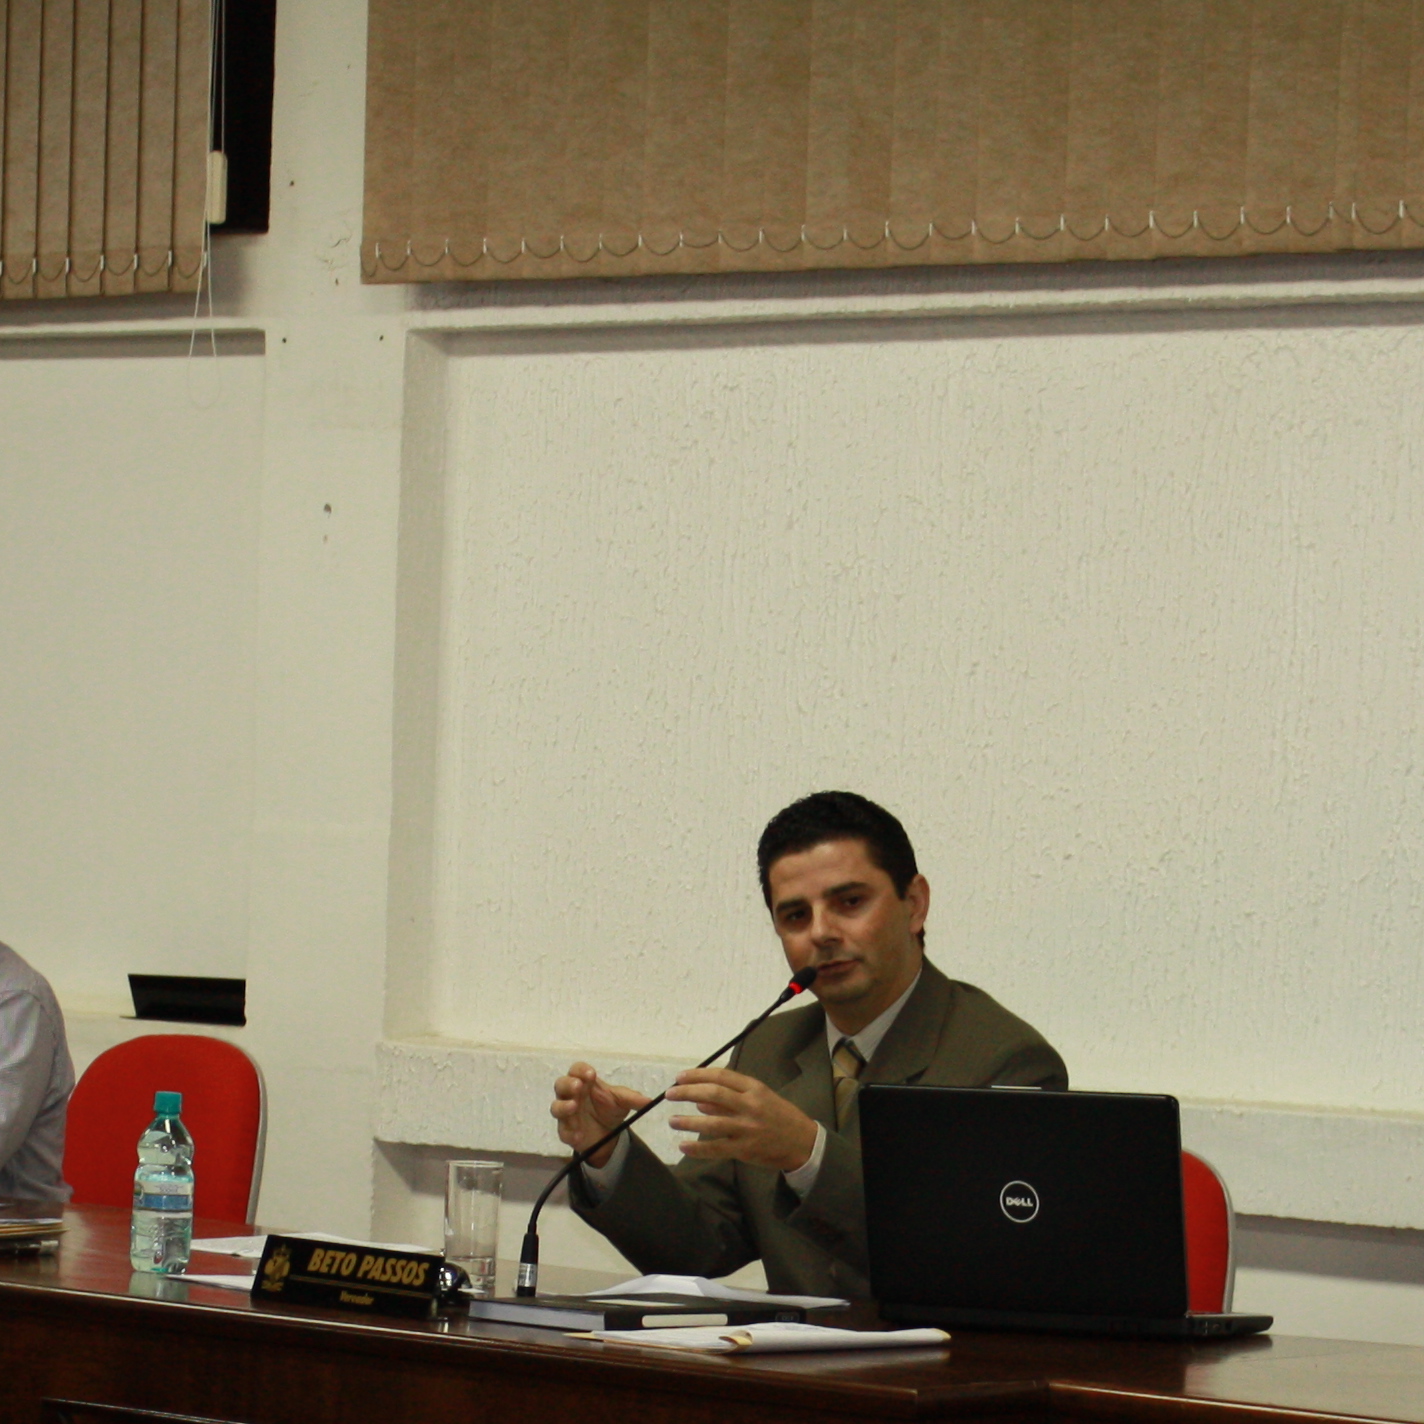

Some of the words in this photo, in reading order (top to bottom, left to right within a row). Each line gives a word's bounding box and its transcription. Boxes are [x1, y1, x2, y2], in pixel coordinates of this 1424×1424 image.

[1005, 1196, 1033, 1207] DELL
[307, 1247, 357, 1277] BETO
[356, 1254, 430, 1287] PASSOS
